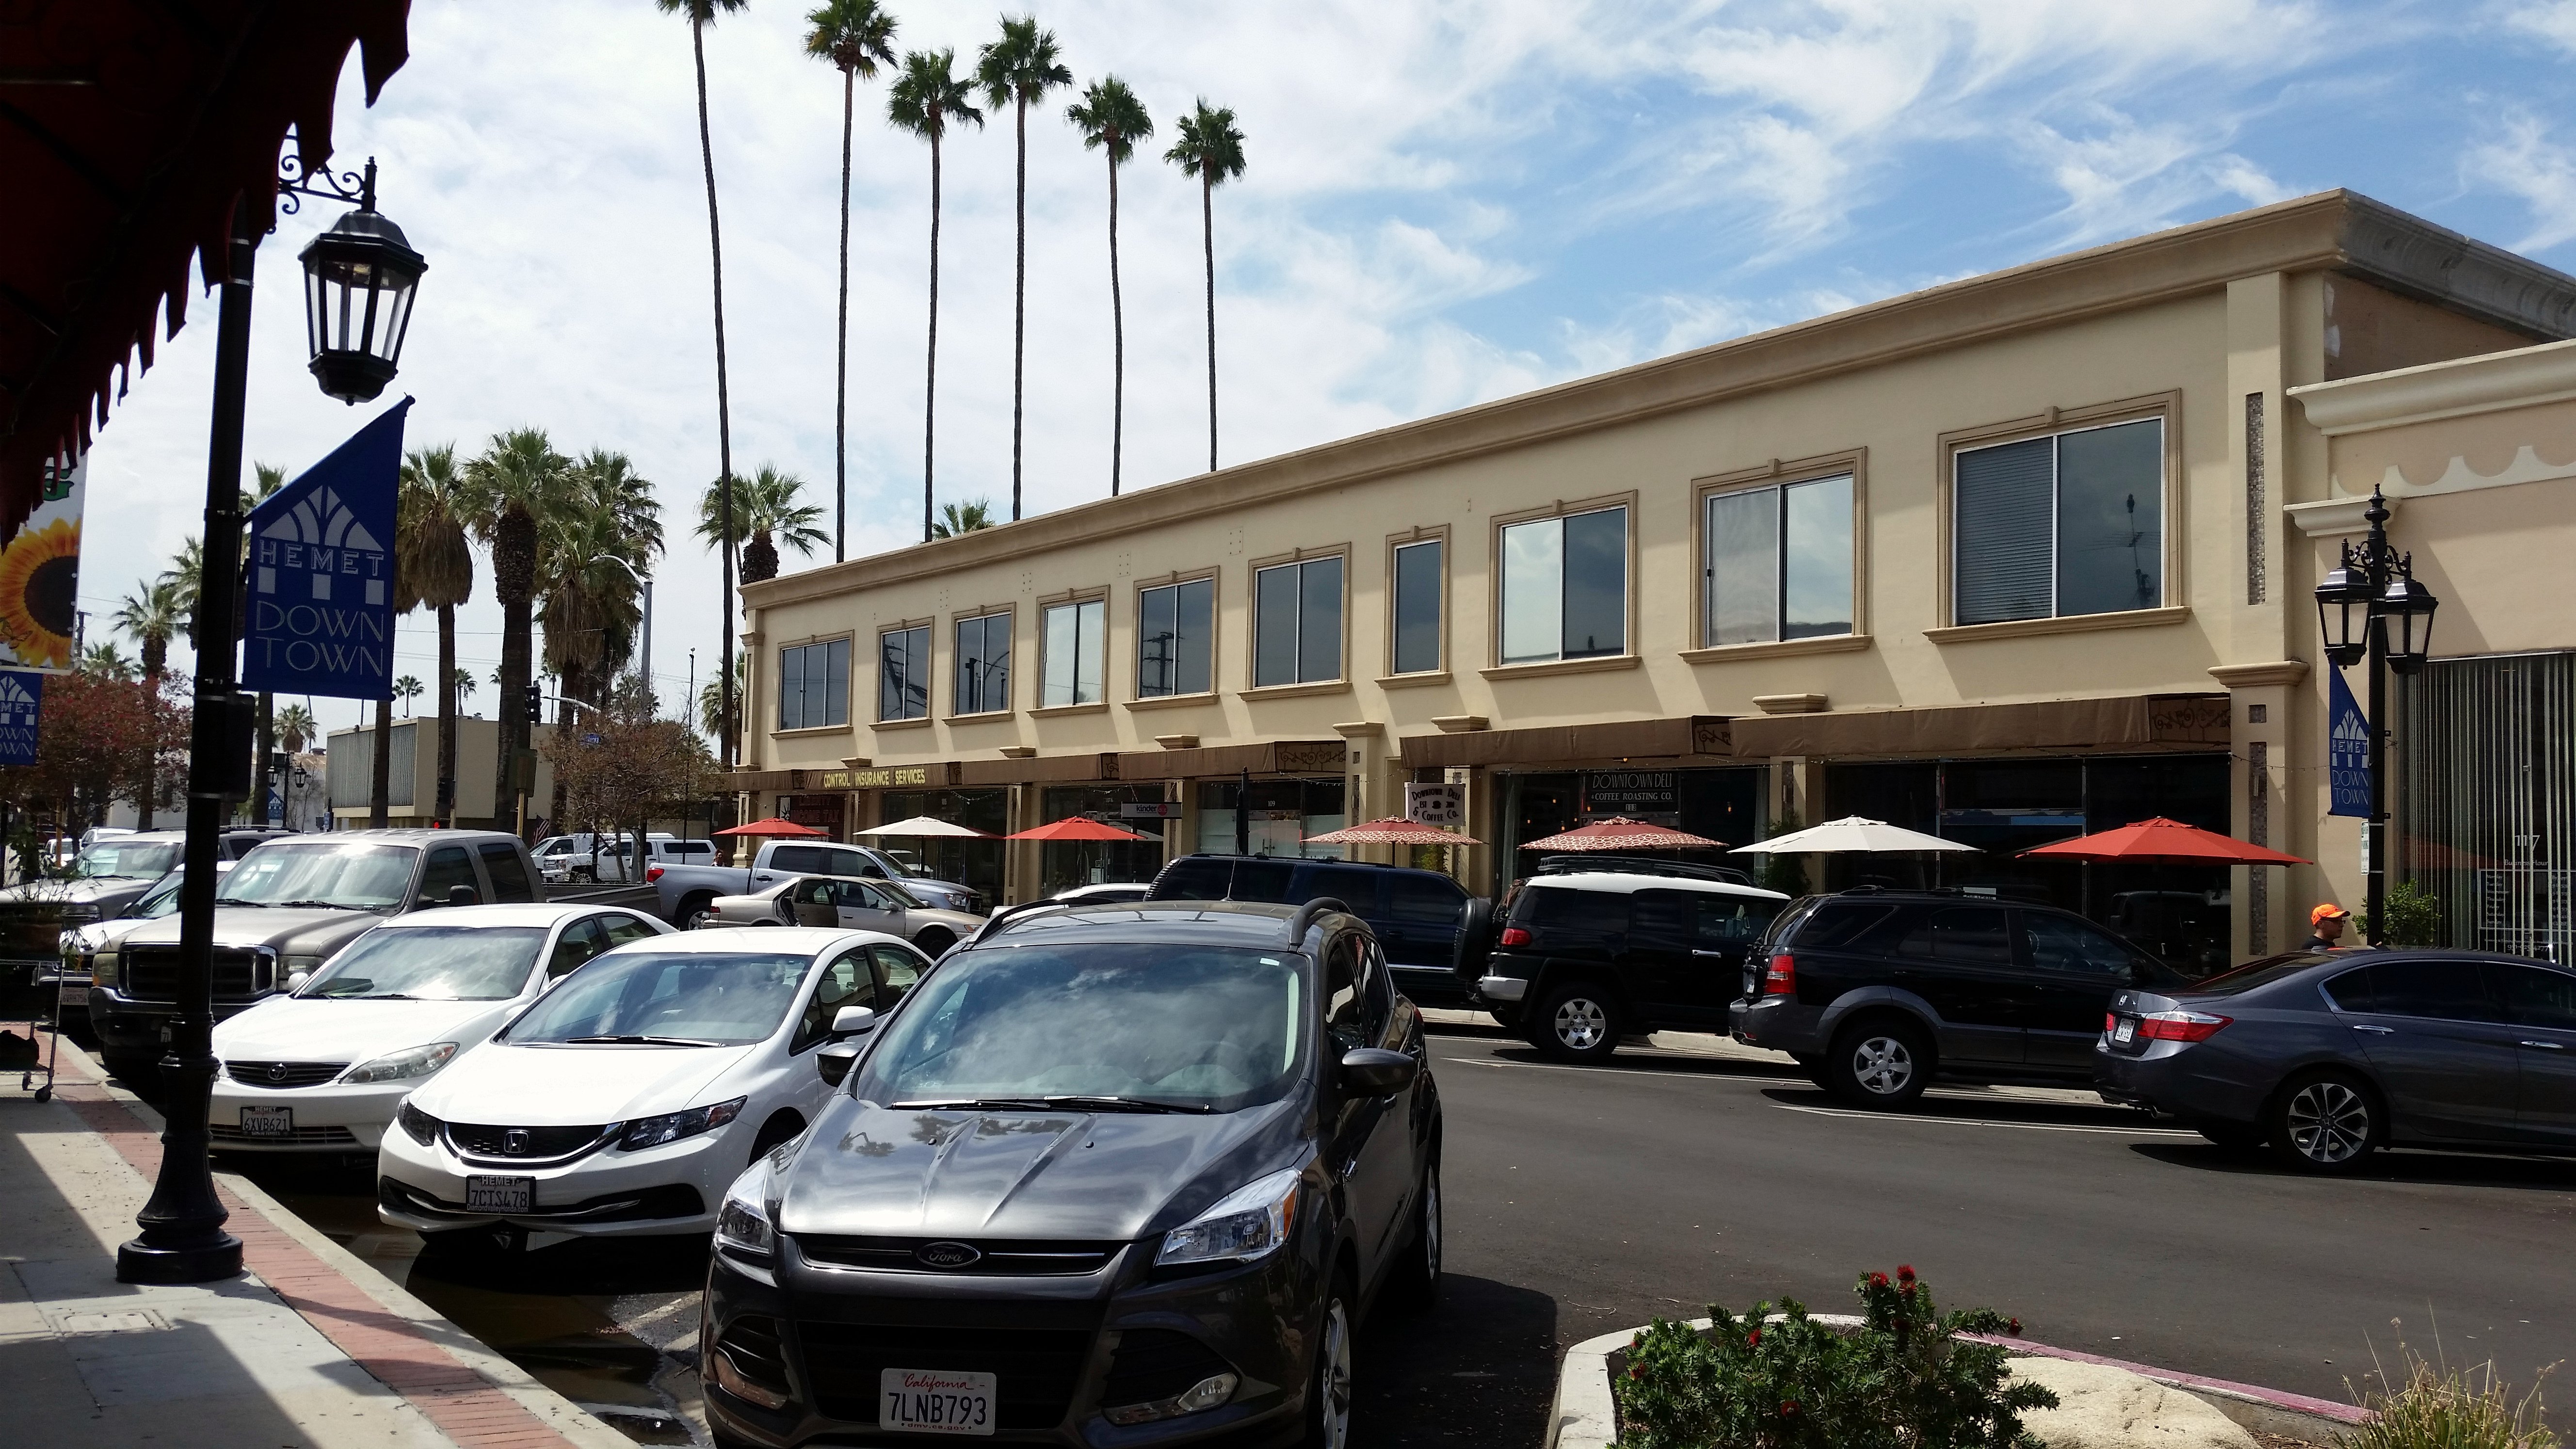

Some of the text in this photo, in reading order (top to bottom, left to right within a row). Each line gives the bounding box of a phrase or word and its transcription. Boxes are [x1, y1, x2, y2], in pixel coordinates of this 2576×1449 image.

[259, 539, 384, 577] HEMET
[256, 600, 384, 643] DOWN
[255, 636, 383, 677] TOWN
[1, 702, 35, 713] MET
[0, 727, 34, 741] WN
[0, 742, 32, 756] WN
[2332, 740, 2367, 754] HEMET
[824, 768, 926, 788] CONTROL INSURANCE SERVICES
[1593, 773, 1672, 788] DOWNTOWN DELI
[2332, 770, 2368, 787] DOWN
[2334, 788, 2368, 805] TOWN
[790, 809, 840, 823] INCOME TAX
[1413, 806, 1419, 816] &
[2514, 835, 2541, 852] 117
[244, 1117, 288, 1131] 6XVB621
[481, 1176, 517, 1186] HEMET
[471, 1190, 528, 1208] 7CTS478
[929, 1245, 965, 1262] Ford
[904, 1373, 974, 1392] California
[888, 1392, 987, 1425] 7LNB793
